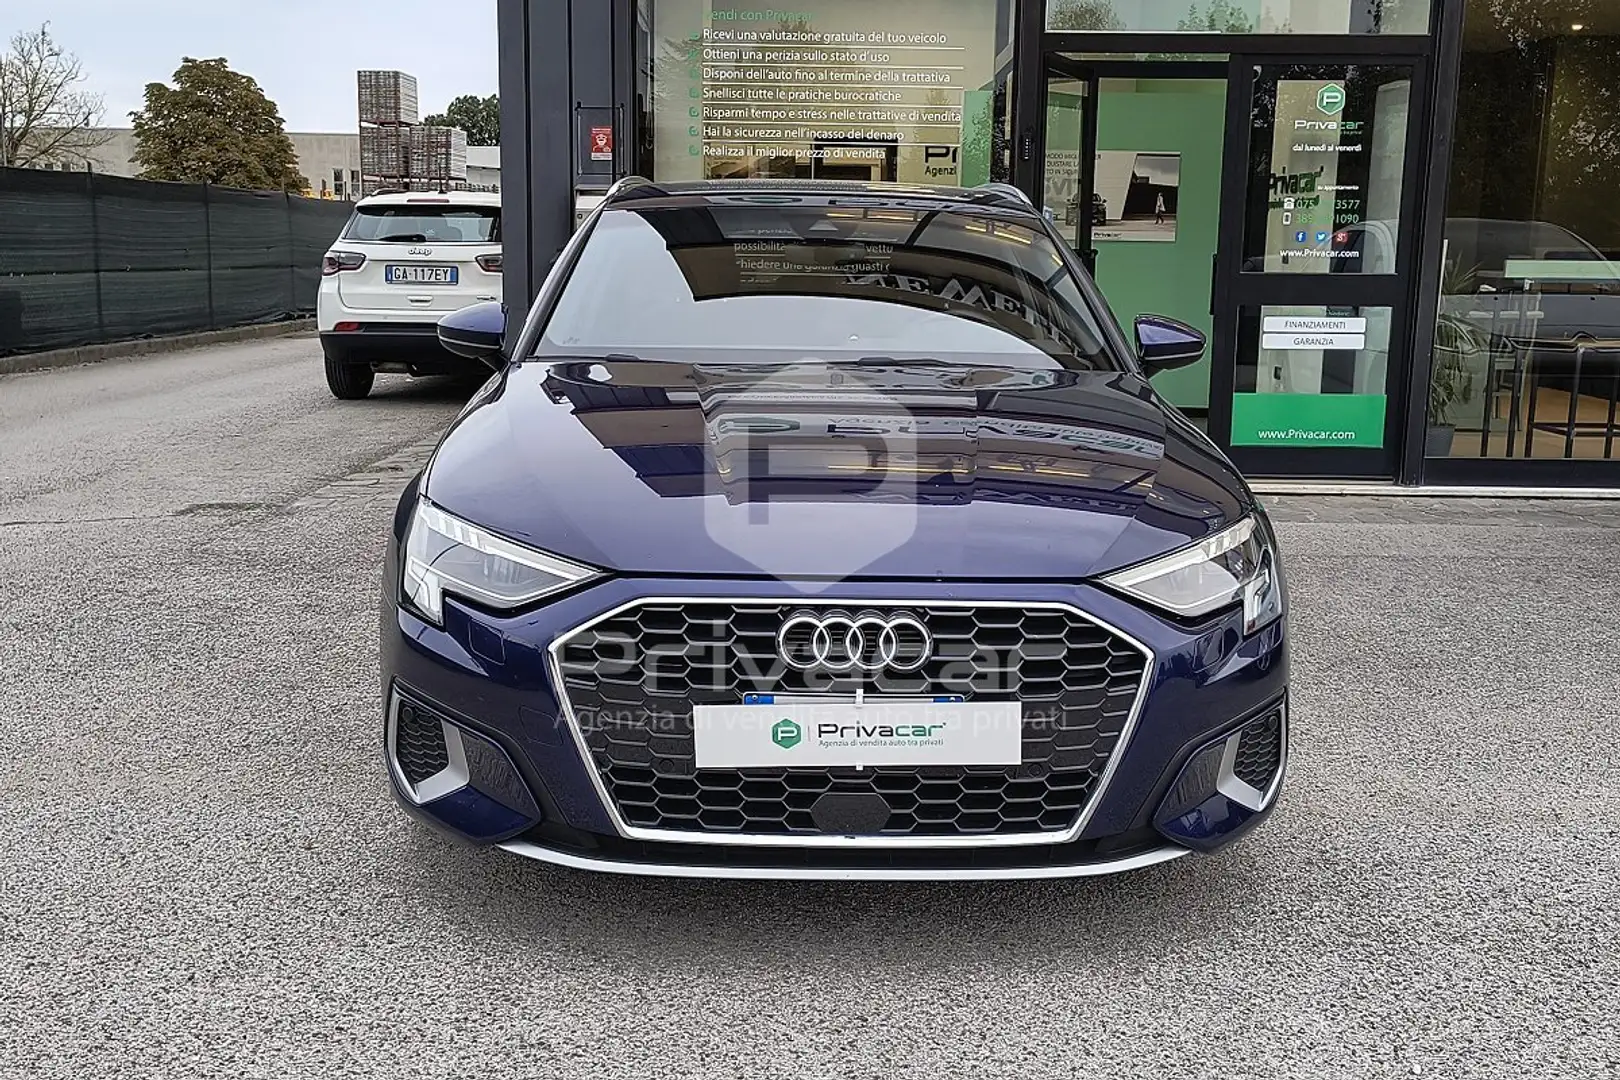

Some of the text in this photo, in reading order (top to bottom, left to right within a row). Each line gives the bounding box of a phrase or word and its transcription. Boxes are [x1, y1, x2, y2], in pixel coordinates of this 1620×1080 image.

[704, 8, 737, 20] endi
[740, 11, 763, 20] con
[703, 29, 947, 44] Ricevi una valutazione gratuita del tuo veicolo
[703, 49, 740, 59] Ottieni
[743, 50, 763, 60] una
[765, 50, 800, 62] perizia
[803, 50, 828, 60] sullo
[830, 51, 857, 61] stato
[703, 67, 951, 83] Disponi dell'auto fino al termine della trattativa
[703, 88, 902, 101] Snellisci tutte le pratiche burocratiche
[703, 107, 961, 122] Risparmi tempo e stress nelle trattative di vendita
[1294, 120, 1364, 130] Privacar
[703, 126, 904, 140] Hai la sicurezza nell'incasso del denaro
[703, 146, 886, 159] Realizza il miglior prezzo di vendita
[1280, 249, 1360, 257] www.Privacar.com
[1284, 320, 1346, 329] FINANZIAMENTI
[1293, 337, 1334, 345] GARANZIA
[1258, 429, 1356, 439] www.Privacar.com
[818, 721, 944, 738] Privacar
[819, 740, 849, 748] Agenzia
[851, 739, 857, 747] di
[859, 739, 887, 747] vendita
[919, 739, 944, 748] privati
